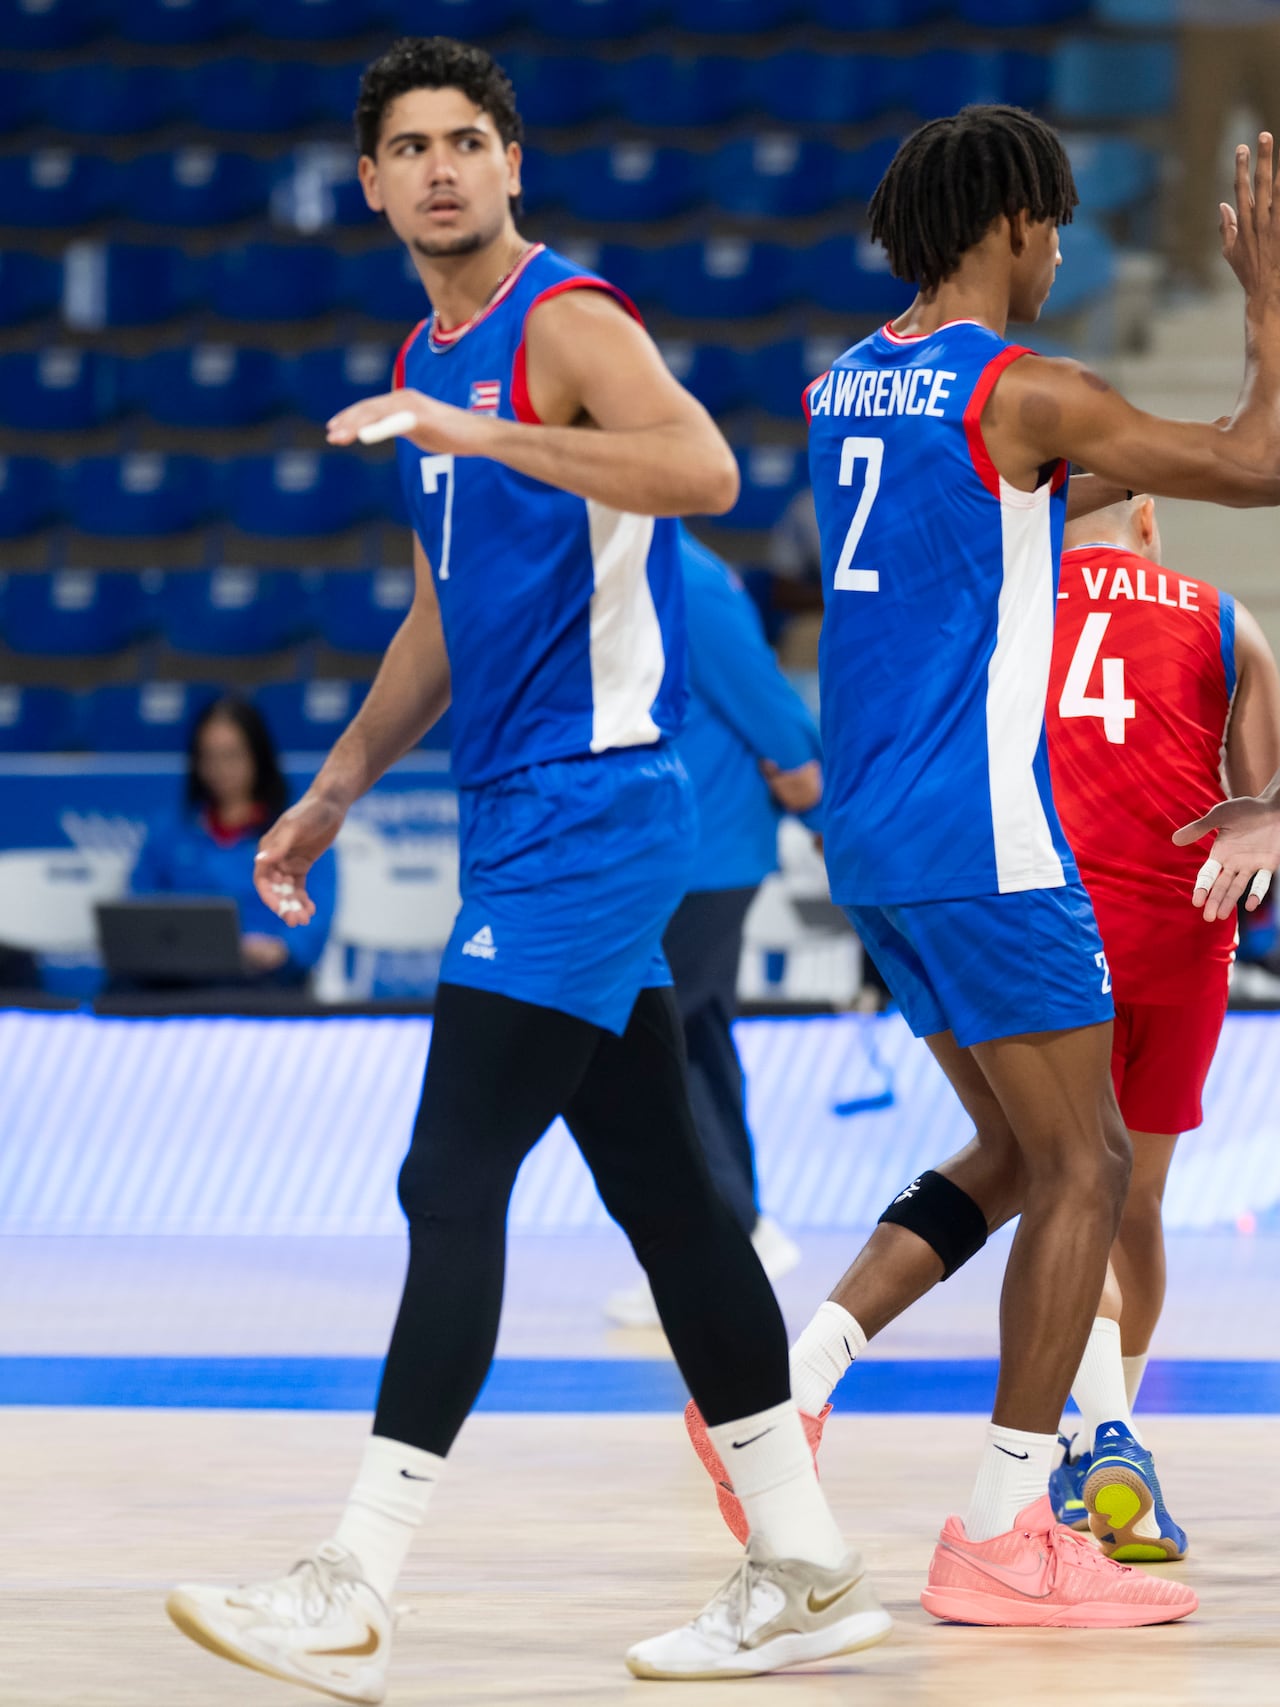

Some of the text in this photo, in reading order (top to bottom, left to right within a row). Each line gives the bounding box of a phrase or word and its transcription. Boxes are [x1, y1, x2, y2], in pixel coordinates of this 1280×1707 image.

[810, 368, 957, 417] LAWRENCE
[420, 453, 455, 580] 7
[833, 436, 885, 593] 2
[1081, 567, 1200, 612] VALLE
[1058, 612, 1136, 745] 4
[1094, 951, 1112, 995] 2
